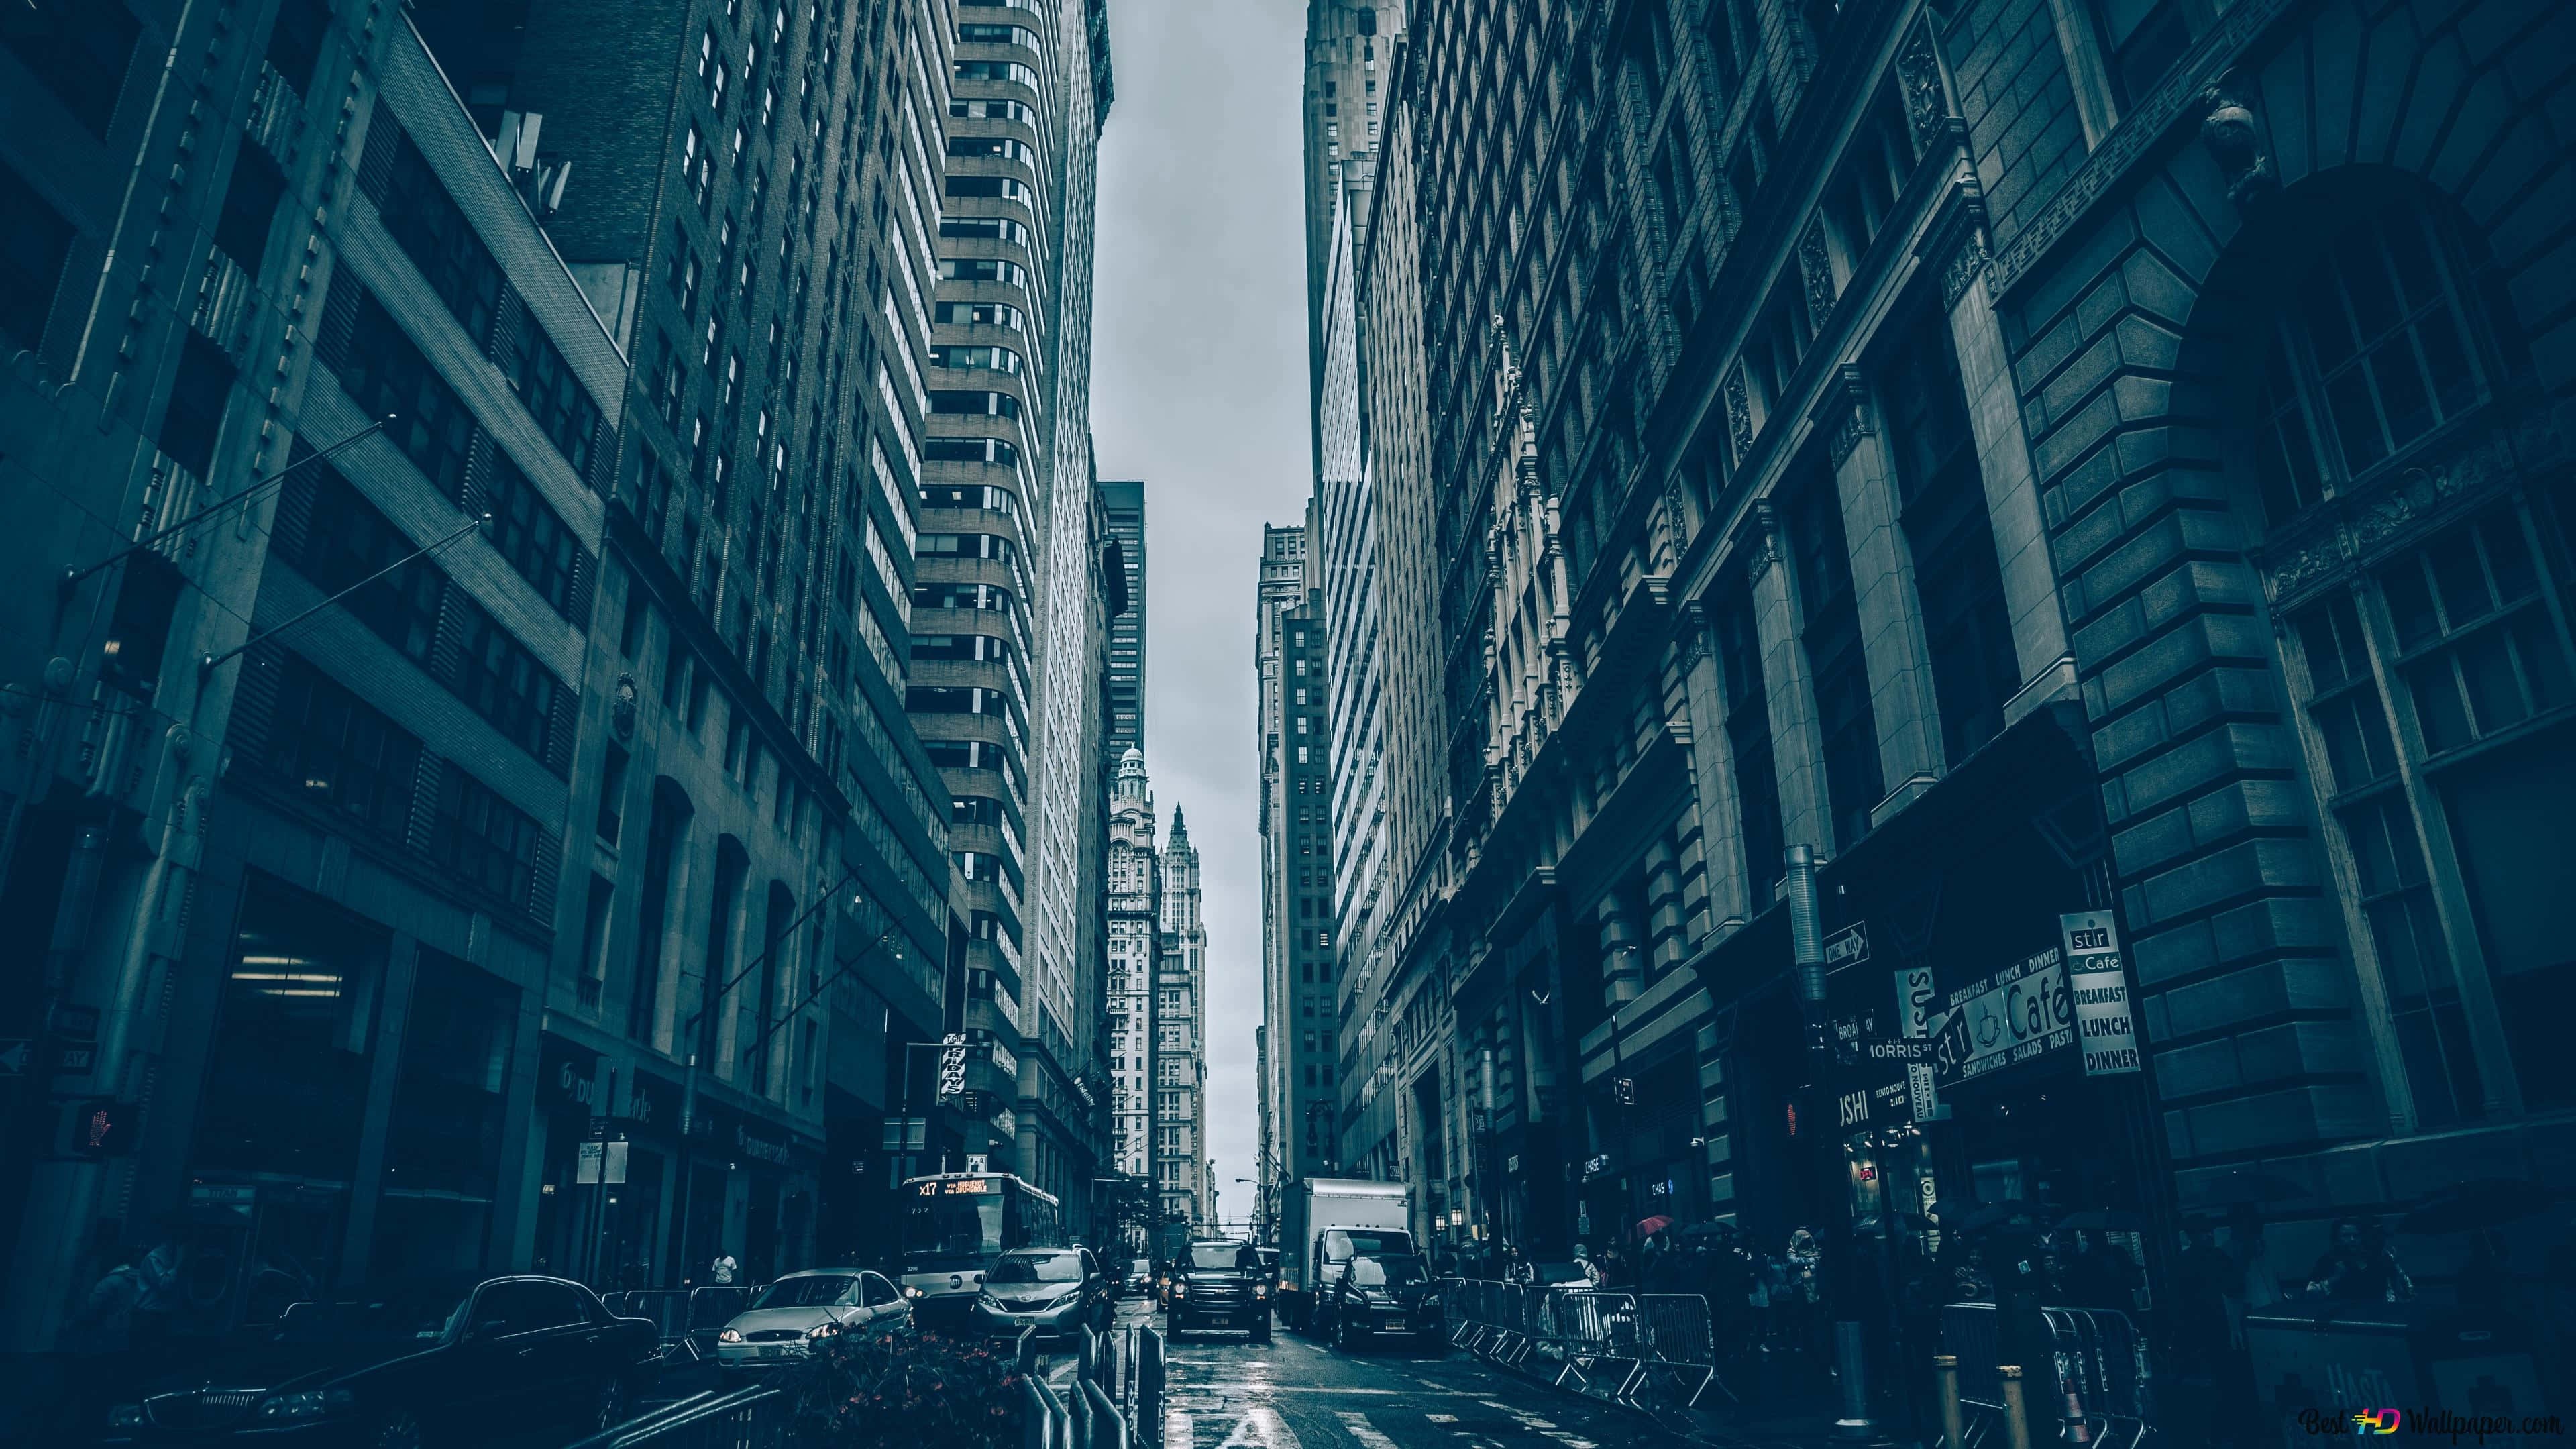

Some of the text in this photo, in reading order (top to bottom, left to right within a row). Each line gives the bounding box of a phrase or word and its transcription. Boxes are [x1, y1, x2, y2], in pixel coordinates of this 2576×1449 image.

[1829, 936, 1860, 961] ONE WAY
[2075, 930, 2104, 948] stir
[2085, 956, 2120, 970] Café
[1949, 947, 2060, 1007] BREAKFAST LUNCH DINNER
[2007, 973, 2072, 1040] Café
[2074, 986, 2126, 1006] BREAKFAST
[2082, 1016, 2131, 1037] LUNCH
[1962, 1051, 2007, 1078] SANDWICHES
[2012, 1038, 2043, 1062] SALADS
[2086, 1048, 2139, 1071] DINNER
[1890, 1081, 1906, 1094] NOUVE
[1911, 1075, 1924, 1119] NOUVEAU
[1585, 1157, 1600, 1175] CHASE
[1652, 1181, 1664, 1196] CHAS
